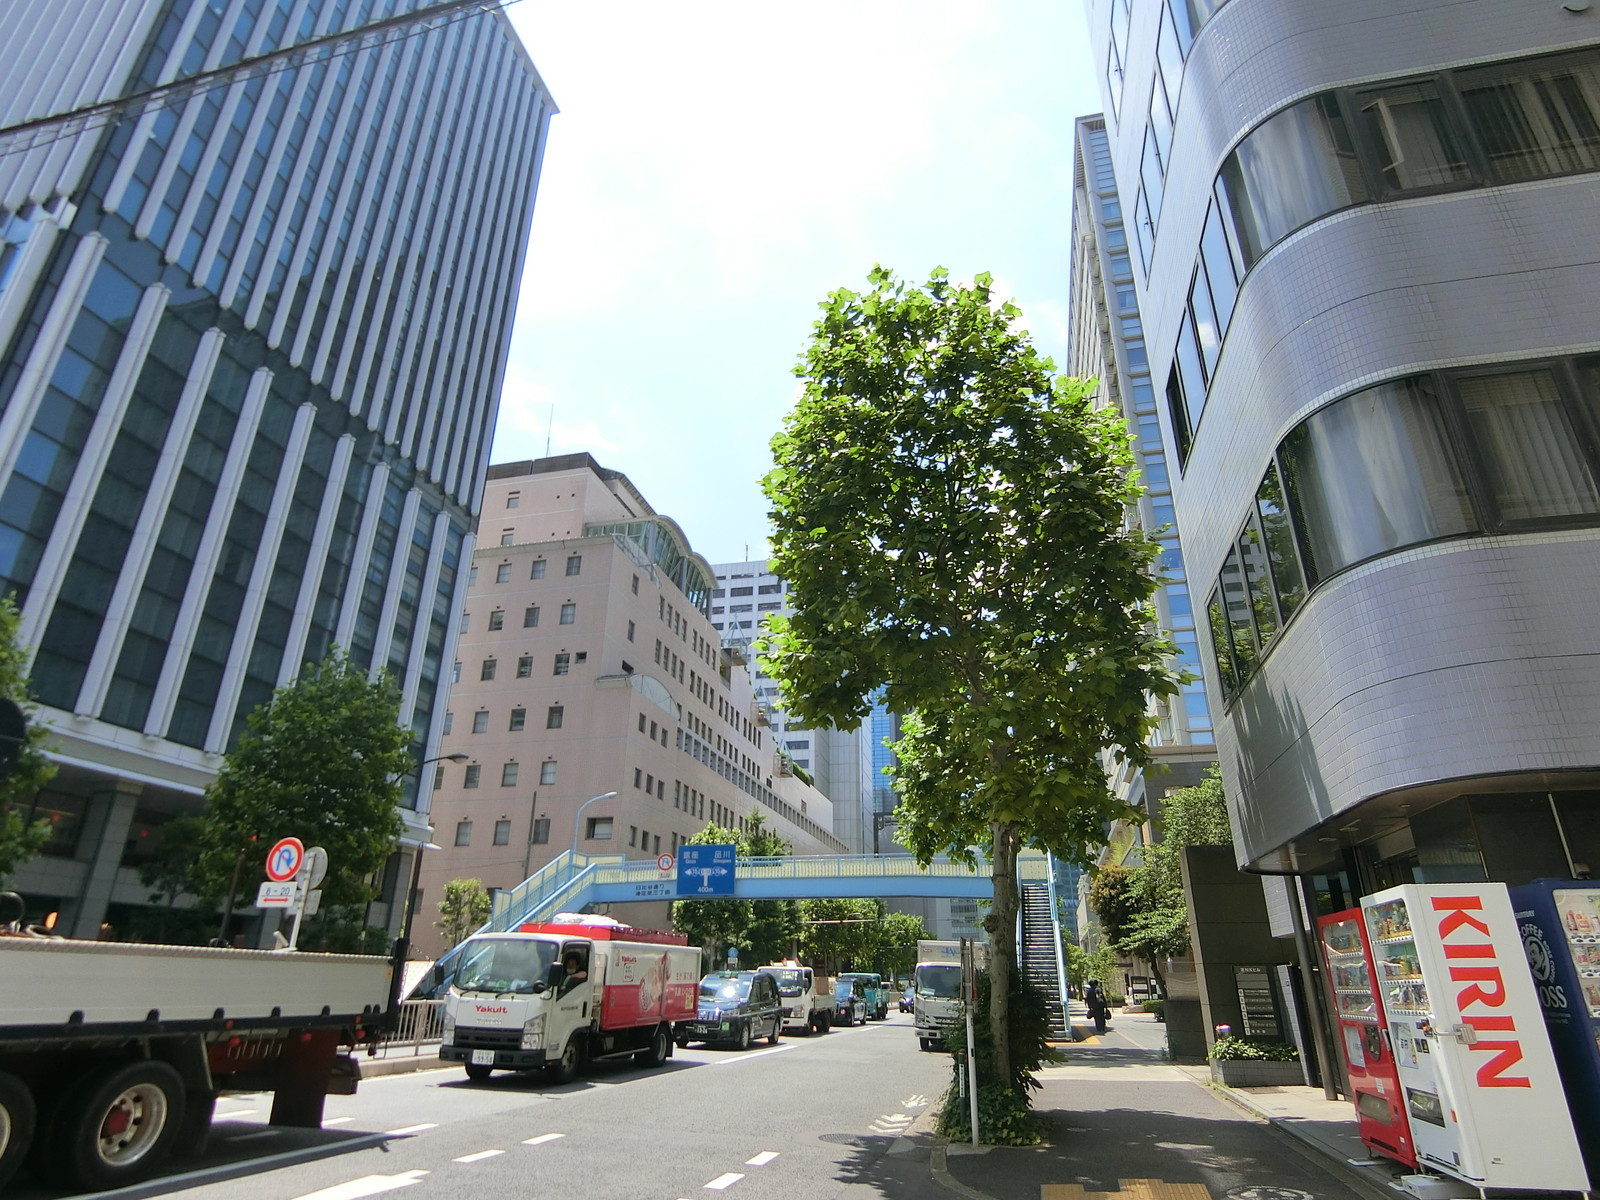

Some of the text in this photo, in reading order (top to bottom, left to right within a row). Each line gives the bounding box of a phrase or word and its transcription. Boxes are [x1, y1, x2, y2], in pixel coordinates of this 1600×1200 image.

[714, 850, 731, 859] 品川
[1431, 896, 1532, 1089] KIRIN
[1539, 985, 1568, 1008] OSS
[475, 1005, 508, 1014] Yakult
